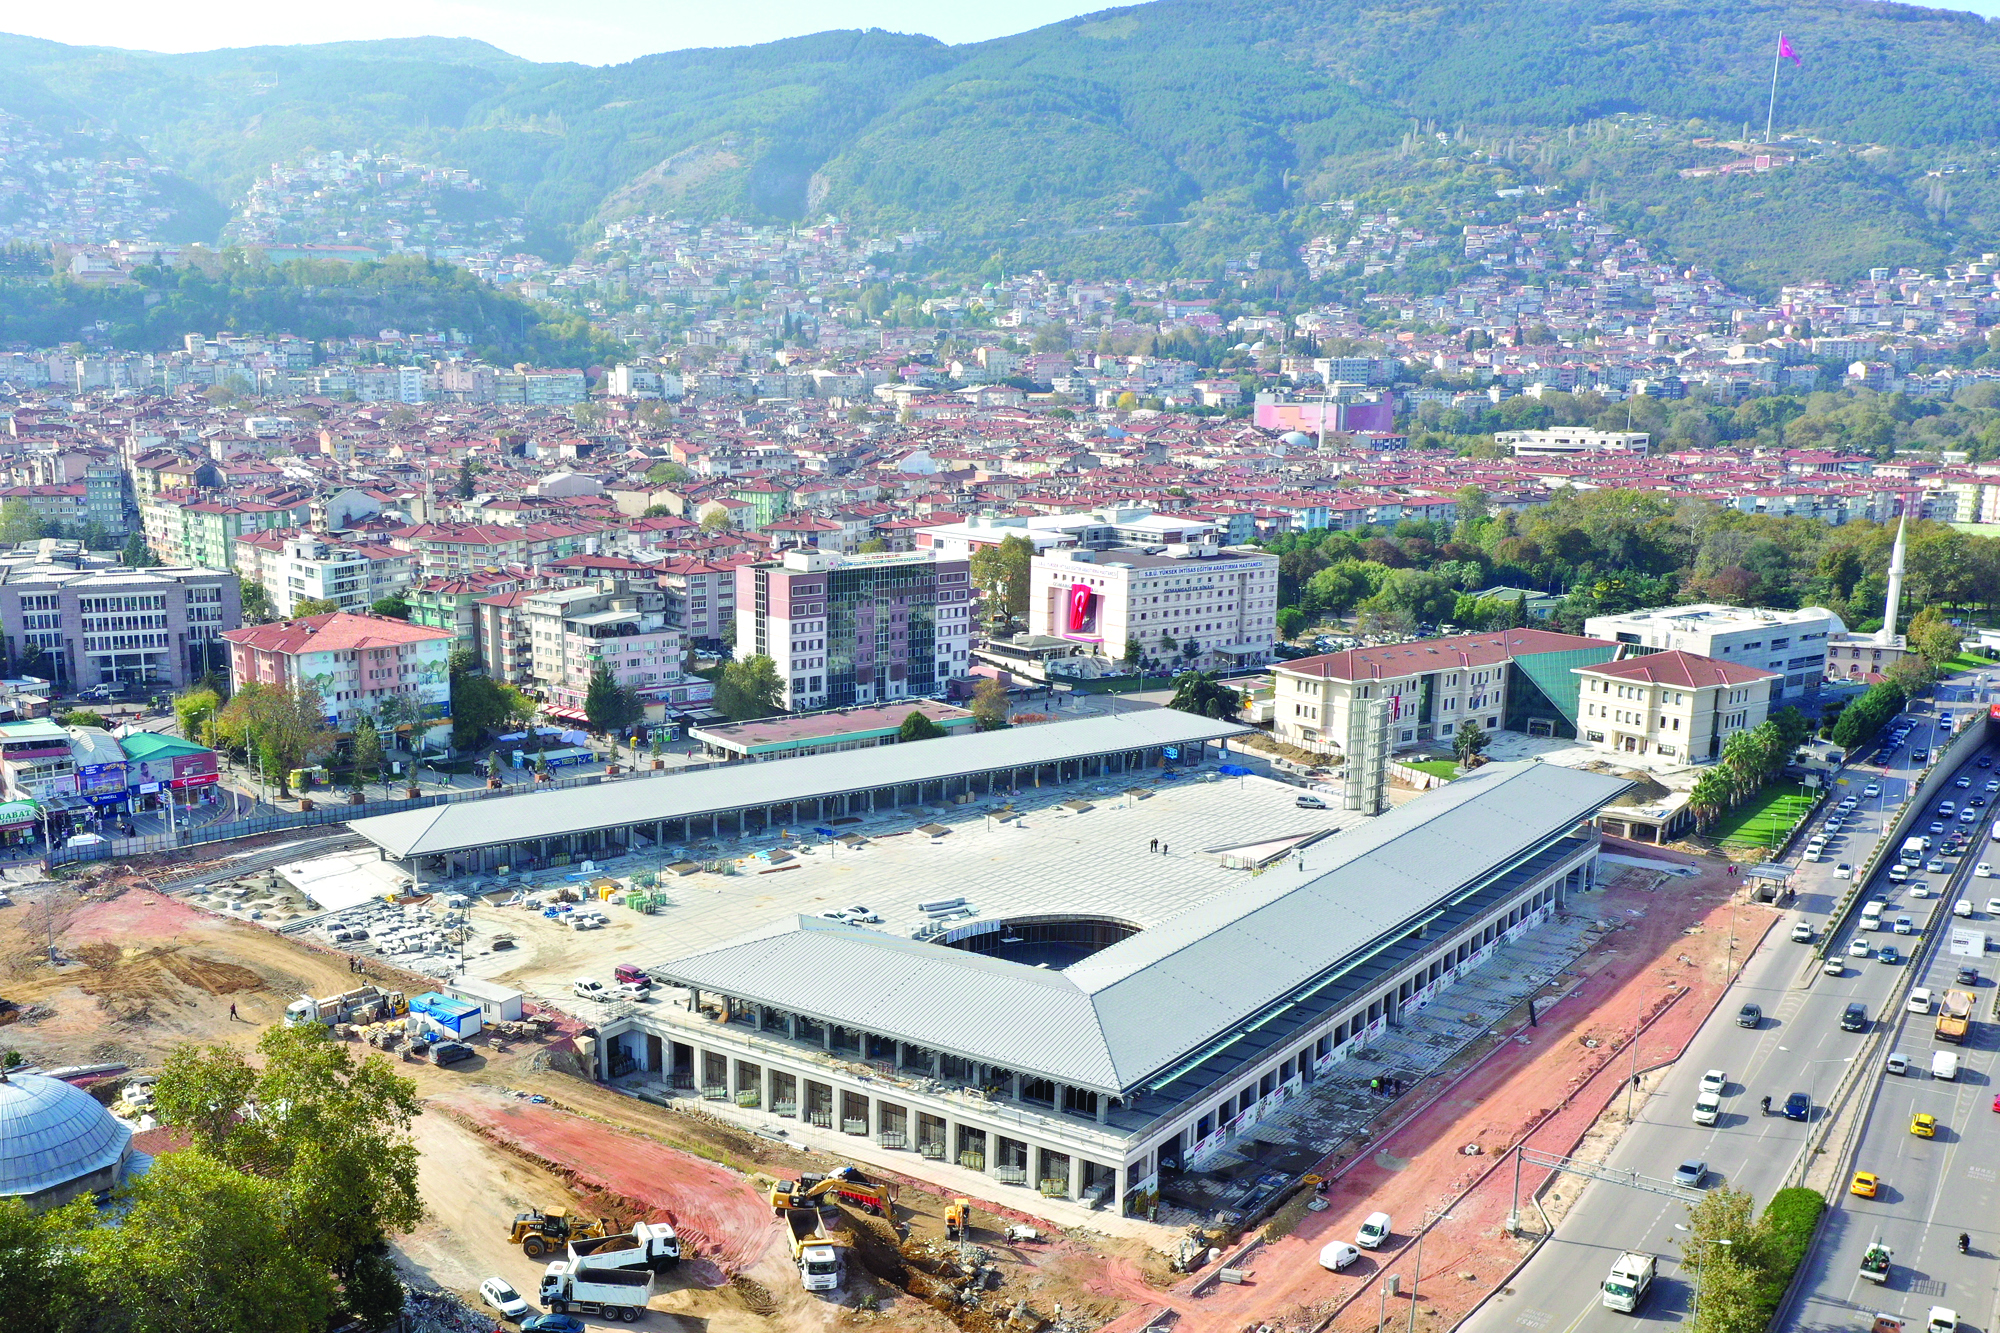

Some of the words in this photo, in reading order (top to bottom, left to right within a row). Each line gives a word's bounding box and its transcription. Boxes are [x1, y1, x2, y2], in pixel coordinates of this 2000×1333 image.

[1159, 568, 1178, 576] YÜKSEK
[1196, 565, 1213, 573] EĞİTİM
[1213, 563, 1238, 572] ARAŞTIRMA
[1238, 561, 1263, 569] HASTANESİ
